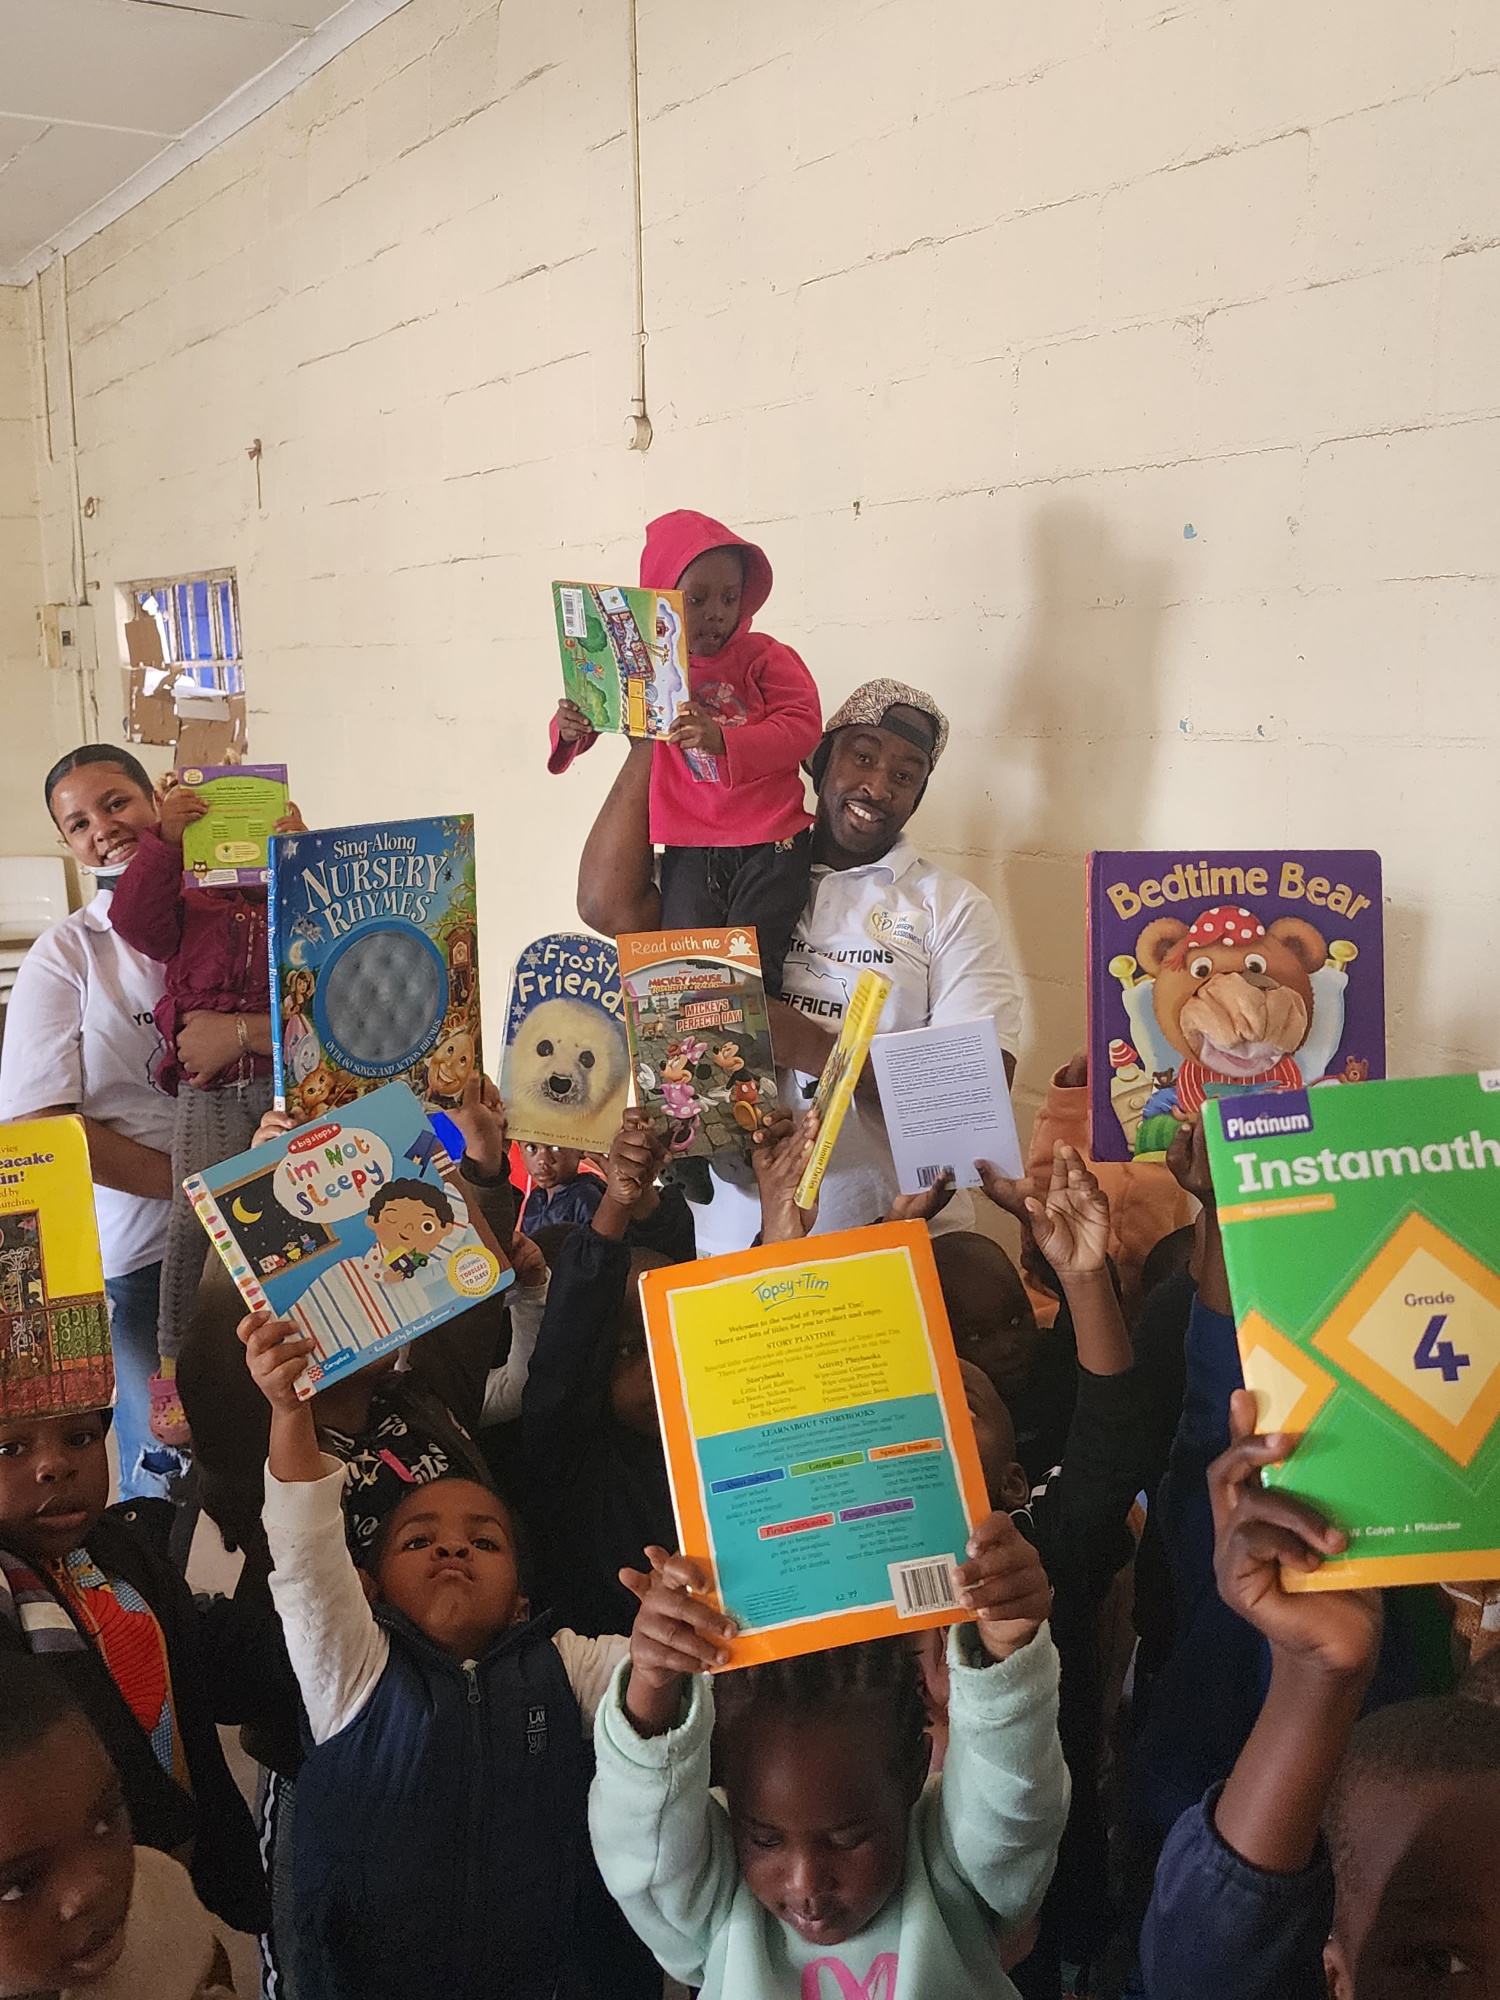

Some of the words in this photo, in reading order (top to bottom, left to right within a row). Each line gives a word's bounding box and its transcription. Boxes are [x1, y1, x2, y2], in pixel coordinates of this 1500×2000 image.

[334, 832, 416, 860] Sing-Along
[301, 854, 448, 914] NURSERY
[1106, 860, 1268, 920] Bedtime
[1278, 862, 1372, 920] Bear
[322, 891, 431, 940] RHYMES
[630, 937, 667, 955] Read
[670, 936, 700, 952] with
[702, 938, 721, 949] me
[543, 944, 618, 983] Frosty
[648, 976, 688, 987] MICKEY
[688, 974, 722, 984] MOUSE
[685, 1000, 729, 1017] MICKEY'S
[676, 1014, 720, 1032] PERFECTO
[721, 1010, 743, 1024] DAY!
[377, 1064, 395, 1076] AND
[1227, 1113, 1310, 1138] Platinum
[818, 1140, 832, 1166] Hunter
[1233, 1130, 1500, 1193] Instamath
[808, 1167, 824, 1190] Davies
[0, 1199, 35, 1208] utchins
[8, 1188, 20, 1198] by
[1404, 1293, 1455, 1307] Grade
[766, 1338, 792, 1349] STORY
[793, 1329, 836, 1343] PLAYTIME
[1413, 1314, 1471, 1382] 4
[1366, 1526, 1395, 1537] Colyn
[1414, 1522, 1461, 1533] Philander
